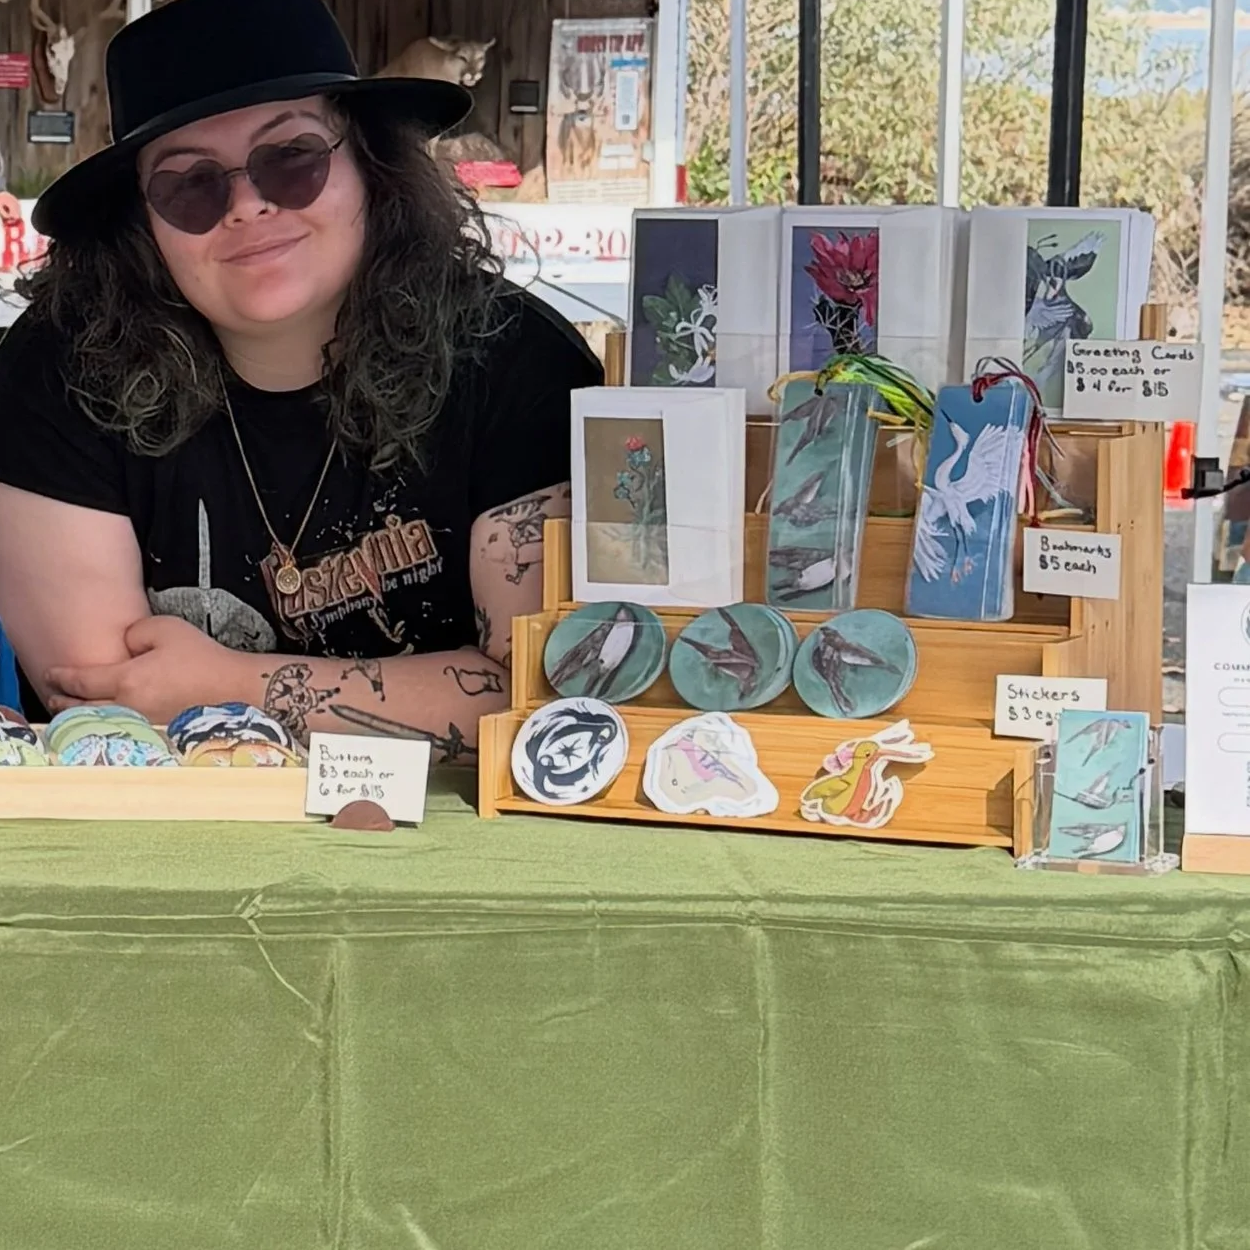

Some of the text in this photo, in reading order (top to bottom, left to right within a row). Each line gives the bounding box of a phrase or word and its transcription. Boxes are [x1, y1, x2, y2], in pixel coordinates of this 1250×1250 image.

[1071, 342, 1195, 364] Greeting Cards
[1111, 365, 1145, 376] each
[1153, 367, 1172, 376] or
[1064, 559, 1097, 575] each
[1007, 683, 1080, 702] Stickers
[343, 768, 374, 779] each
[378, 771, 395, 779] or
[319, 783, 330, 796] 6
[337, 783, 356, 794] for
